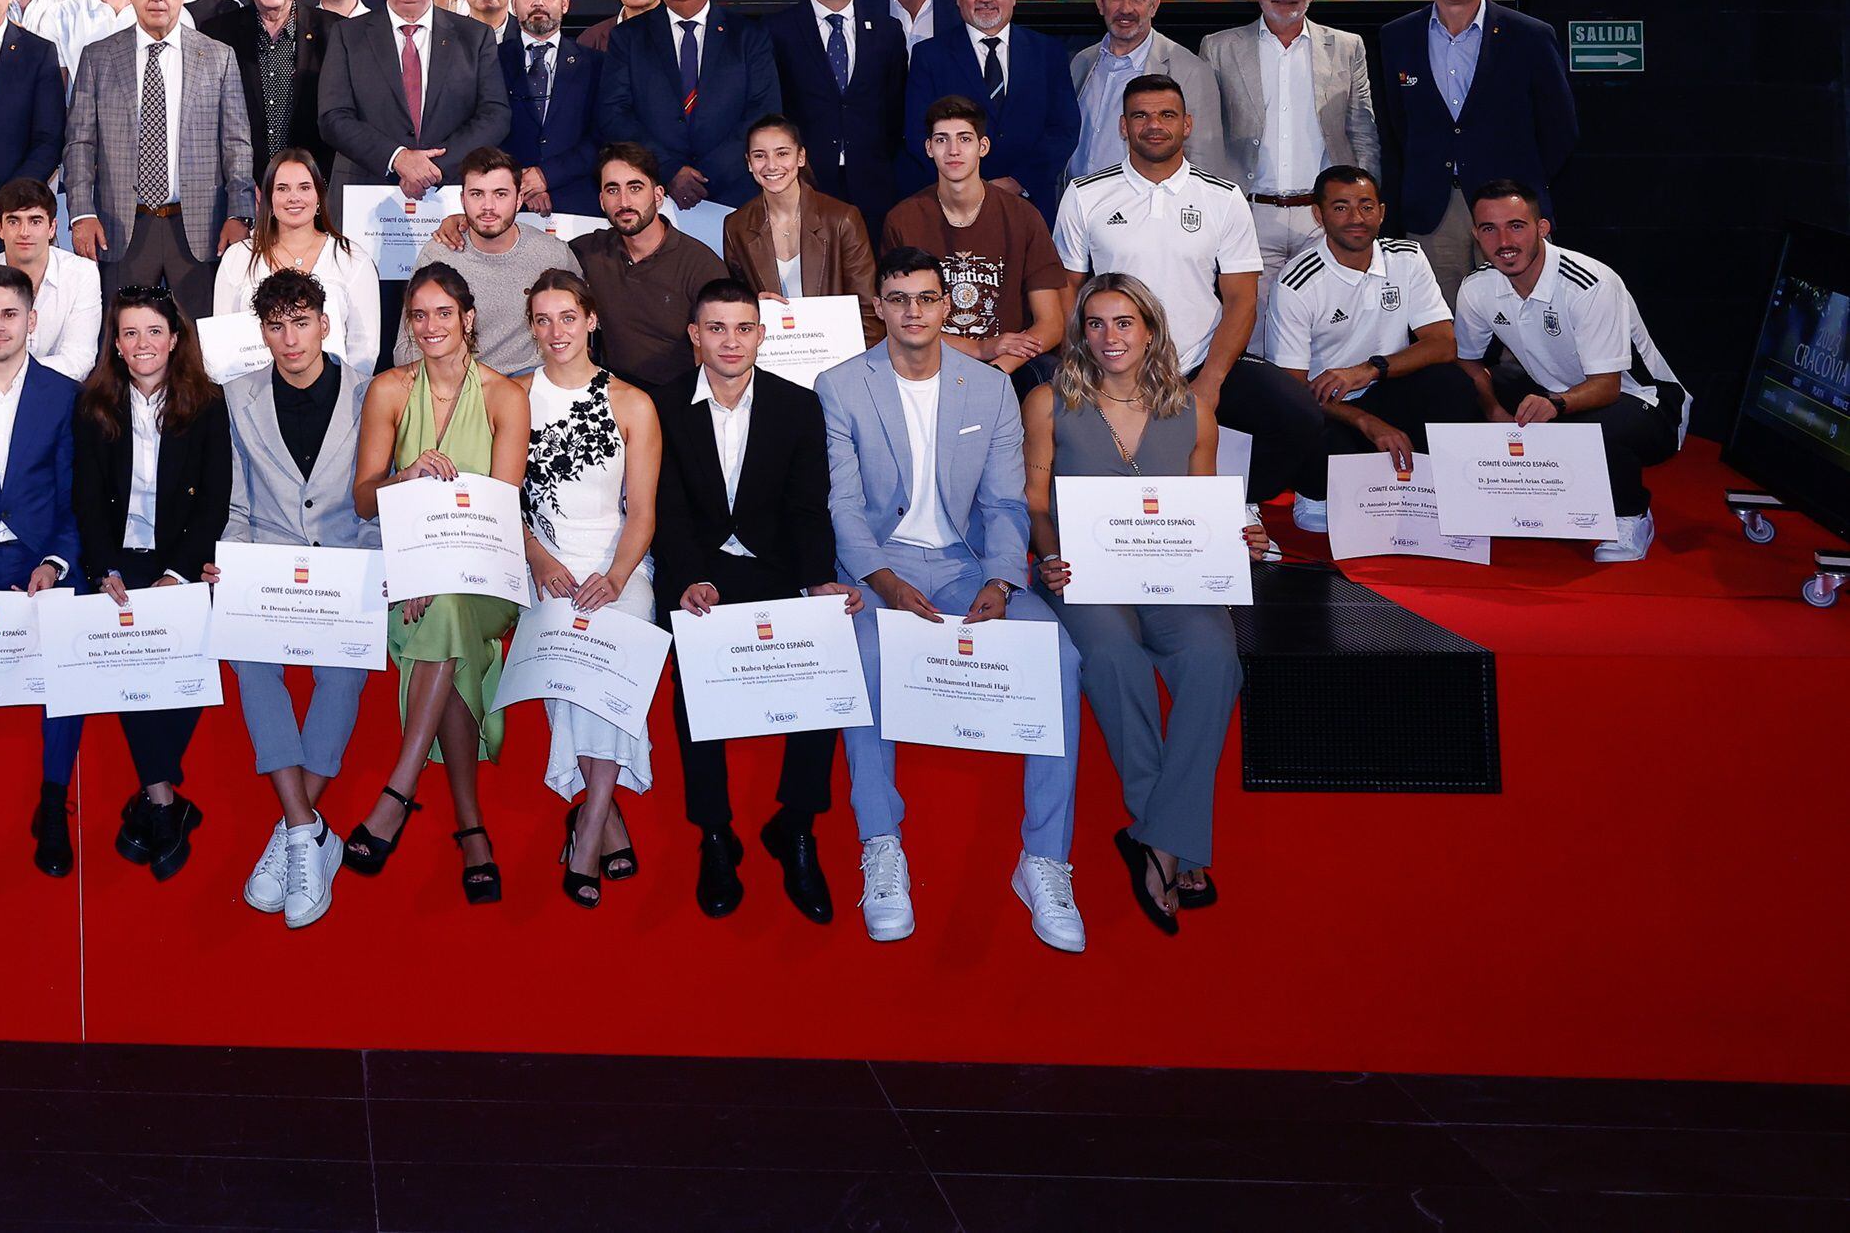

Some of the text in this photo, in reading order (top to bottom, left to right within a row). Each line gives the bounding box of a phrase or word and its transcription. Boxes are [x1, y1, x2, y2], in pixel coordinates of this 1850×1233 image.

[1575, 26, 1637, 42] SALIDA
[1330, 315, 1349, 325] adidas
[1794, 343, 1849, 387] CRACOVIA
[1502, 460, 1531, 468] OLÍMPICO
[1533, 460, 1559, 468] ESPAÑOL
[1417, 486, 1436, 494] ESPAÑ
[427, 512, 498, 524] COMITÉ OLÍMPICO ESPAÑOL
[1109, 517, 1196, 526] COMITÉ OLÍMPICO ESPAÑOL
[261, 586, 341, 598] COMITÉ OLÍMPICO ESPAÑOL
[291, 606, 318, 614] González
[2, 628, 27, 637] ESPAÑOL
[88, 628, 168, 640] COMITÉ OLÍMPICO ESPAÑOL
[560, 631, 589, 641] OLÍMPICO
[591, 637, 617, 651] ESPAÑOL
[730, 640, 814, 654] COMITÉ OLÍMPICO ESPAÑOL
[569, 647, 589, 657] García
[590, 653, 610, 664] García
[762, 663, 785, 671] Iglesias
[787, 661, 819, 670] Fernández
[926, 656, 1009, 671] COMITÉ OLÍMPICO ESPAÑOL
[935, 677, 970, 687] Mohammed
[971, 681, 992, 689] Hamdi
[994, 683, 1010, 691] Hajji
